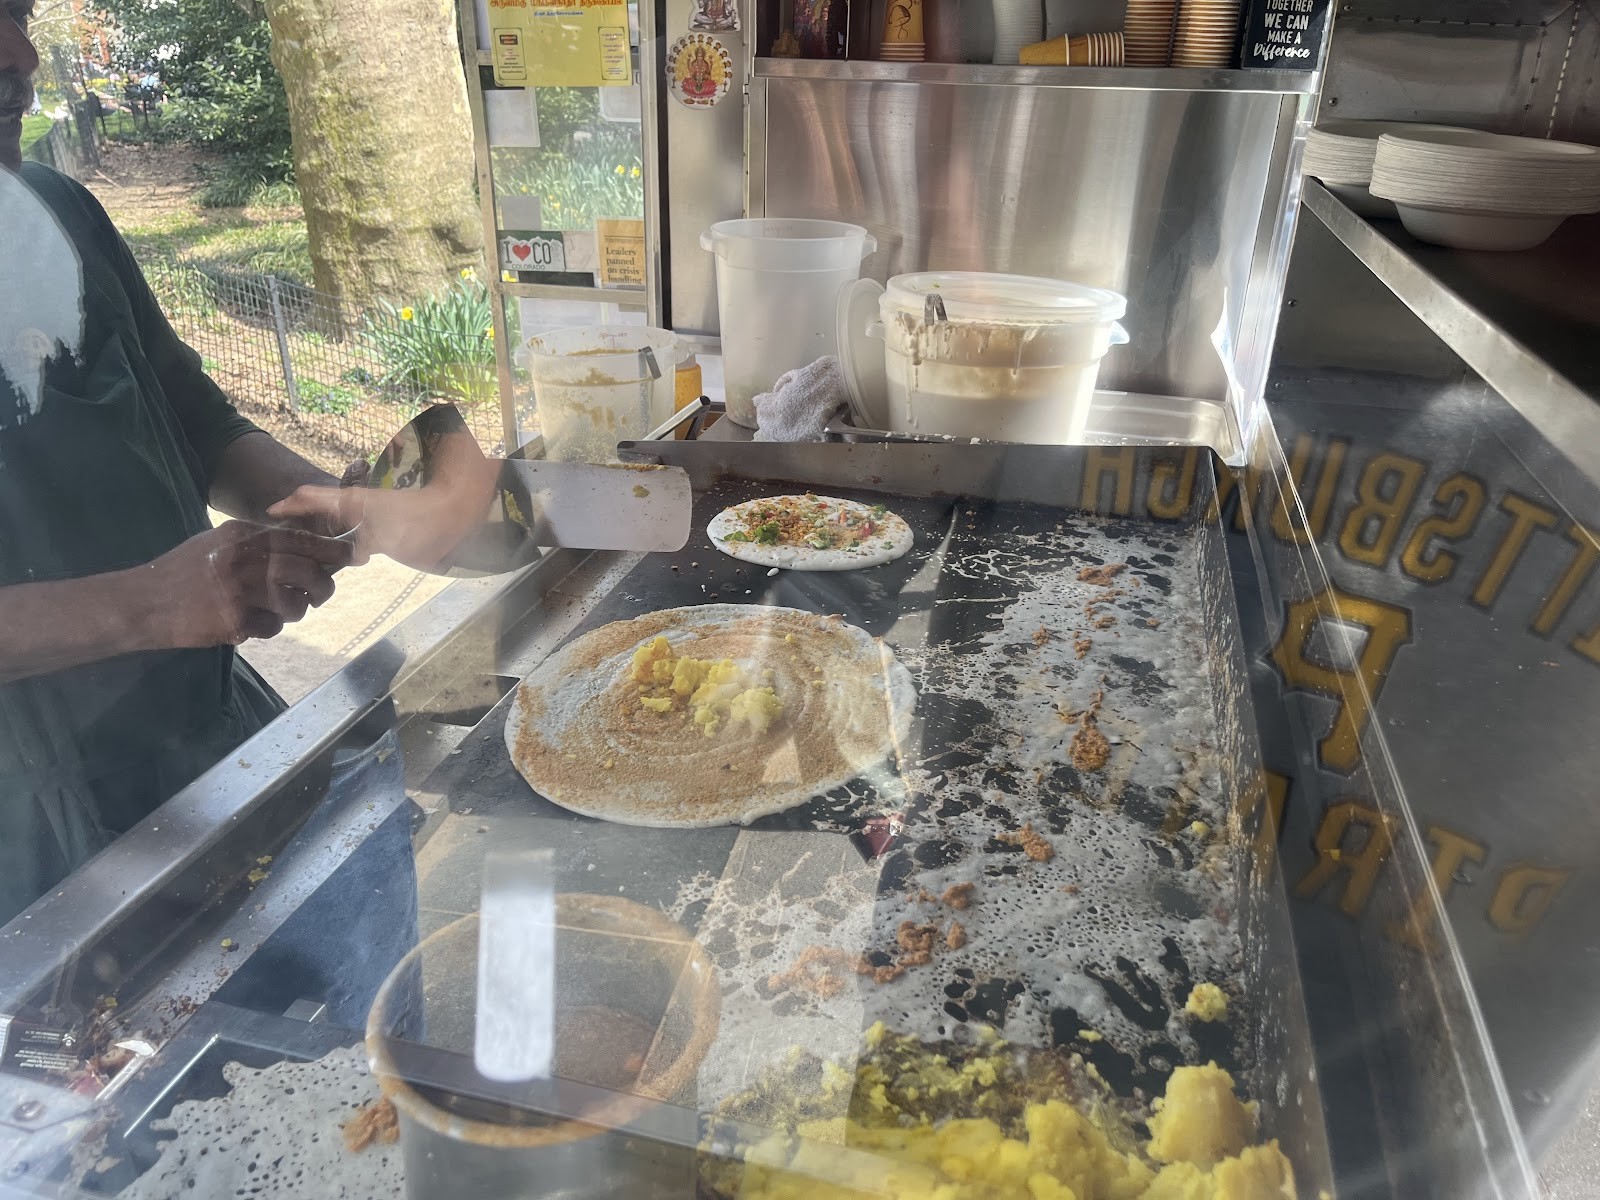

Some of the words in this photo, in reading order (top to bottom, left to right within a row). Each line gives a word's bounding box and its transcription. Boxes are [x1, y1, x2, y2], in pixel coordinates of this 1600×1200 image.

[1267, 0, 1313, 12] TOGETHER
[1265, 13, 1283, 28] WE
[1286, 15, 1309, 30] CAN
[1267, 30, 1293, 43] MAKE
[1294, 31, 1301, 44] A
[1254, 43, 1310, 60] Difference
[504, 241, 512, 264] I
[533, 242, 551, 264] CO
[606, 247, 636, 256] Leaders
[607, 257, 635, 266] panned
[620, 267, 640, 275] crisis
[608, 275, 642, 284] handling
